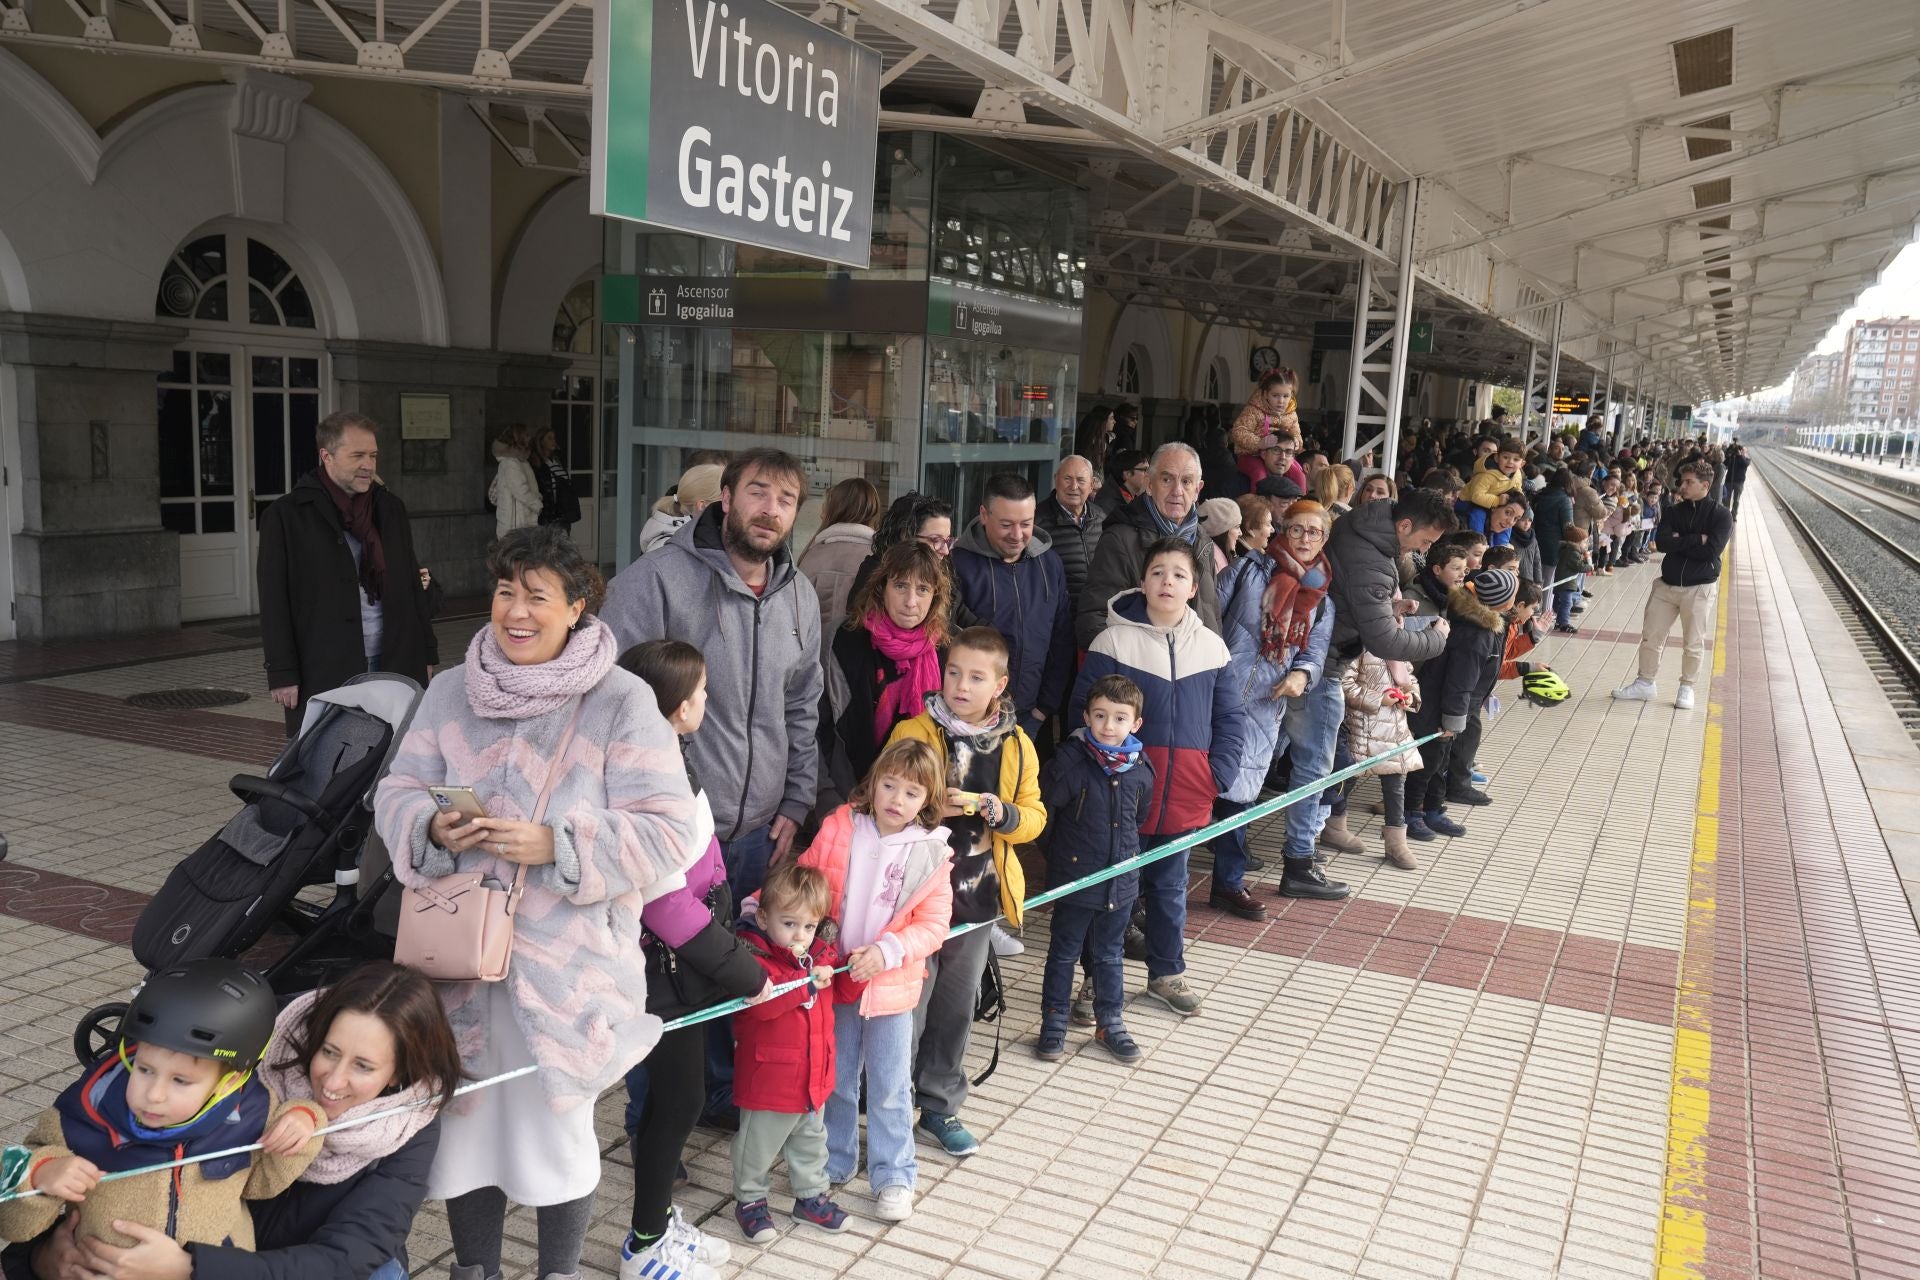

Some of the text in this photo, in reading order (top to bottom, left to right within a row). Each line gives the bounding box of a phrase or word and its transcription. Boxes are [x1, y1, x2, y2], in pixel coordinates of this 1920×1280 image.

[686, 0, 839, 127] Vitoria
[678, 125, 854, 243] Gasteiz
[676, 284, 729, 299] Ascensor
[676, 303, 734, 321] Igogailua
[972, 299, 1001, 316] Ascensor
[972, 318, 1002, 336] Igogailua
[213, 1048, 237, 1058] BTWIN
